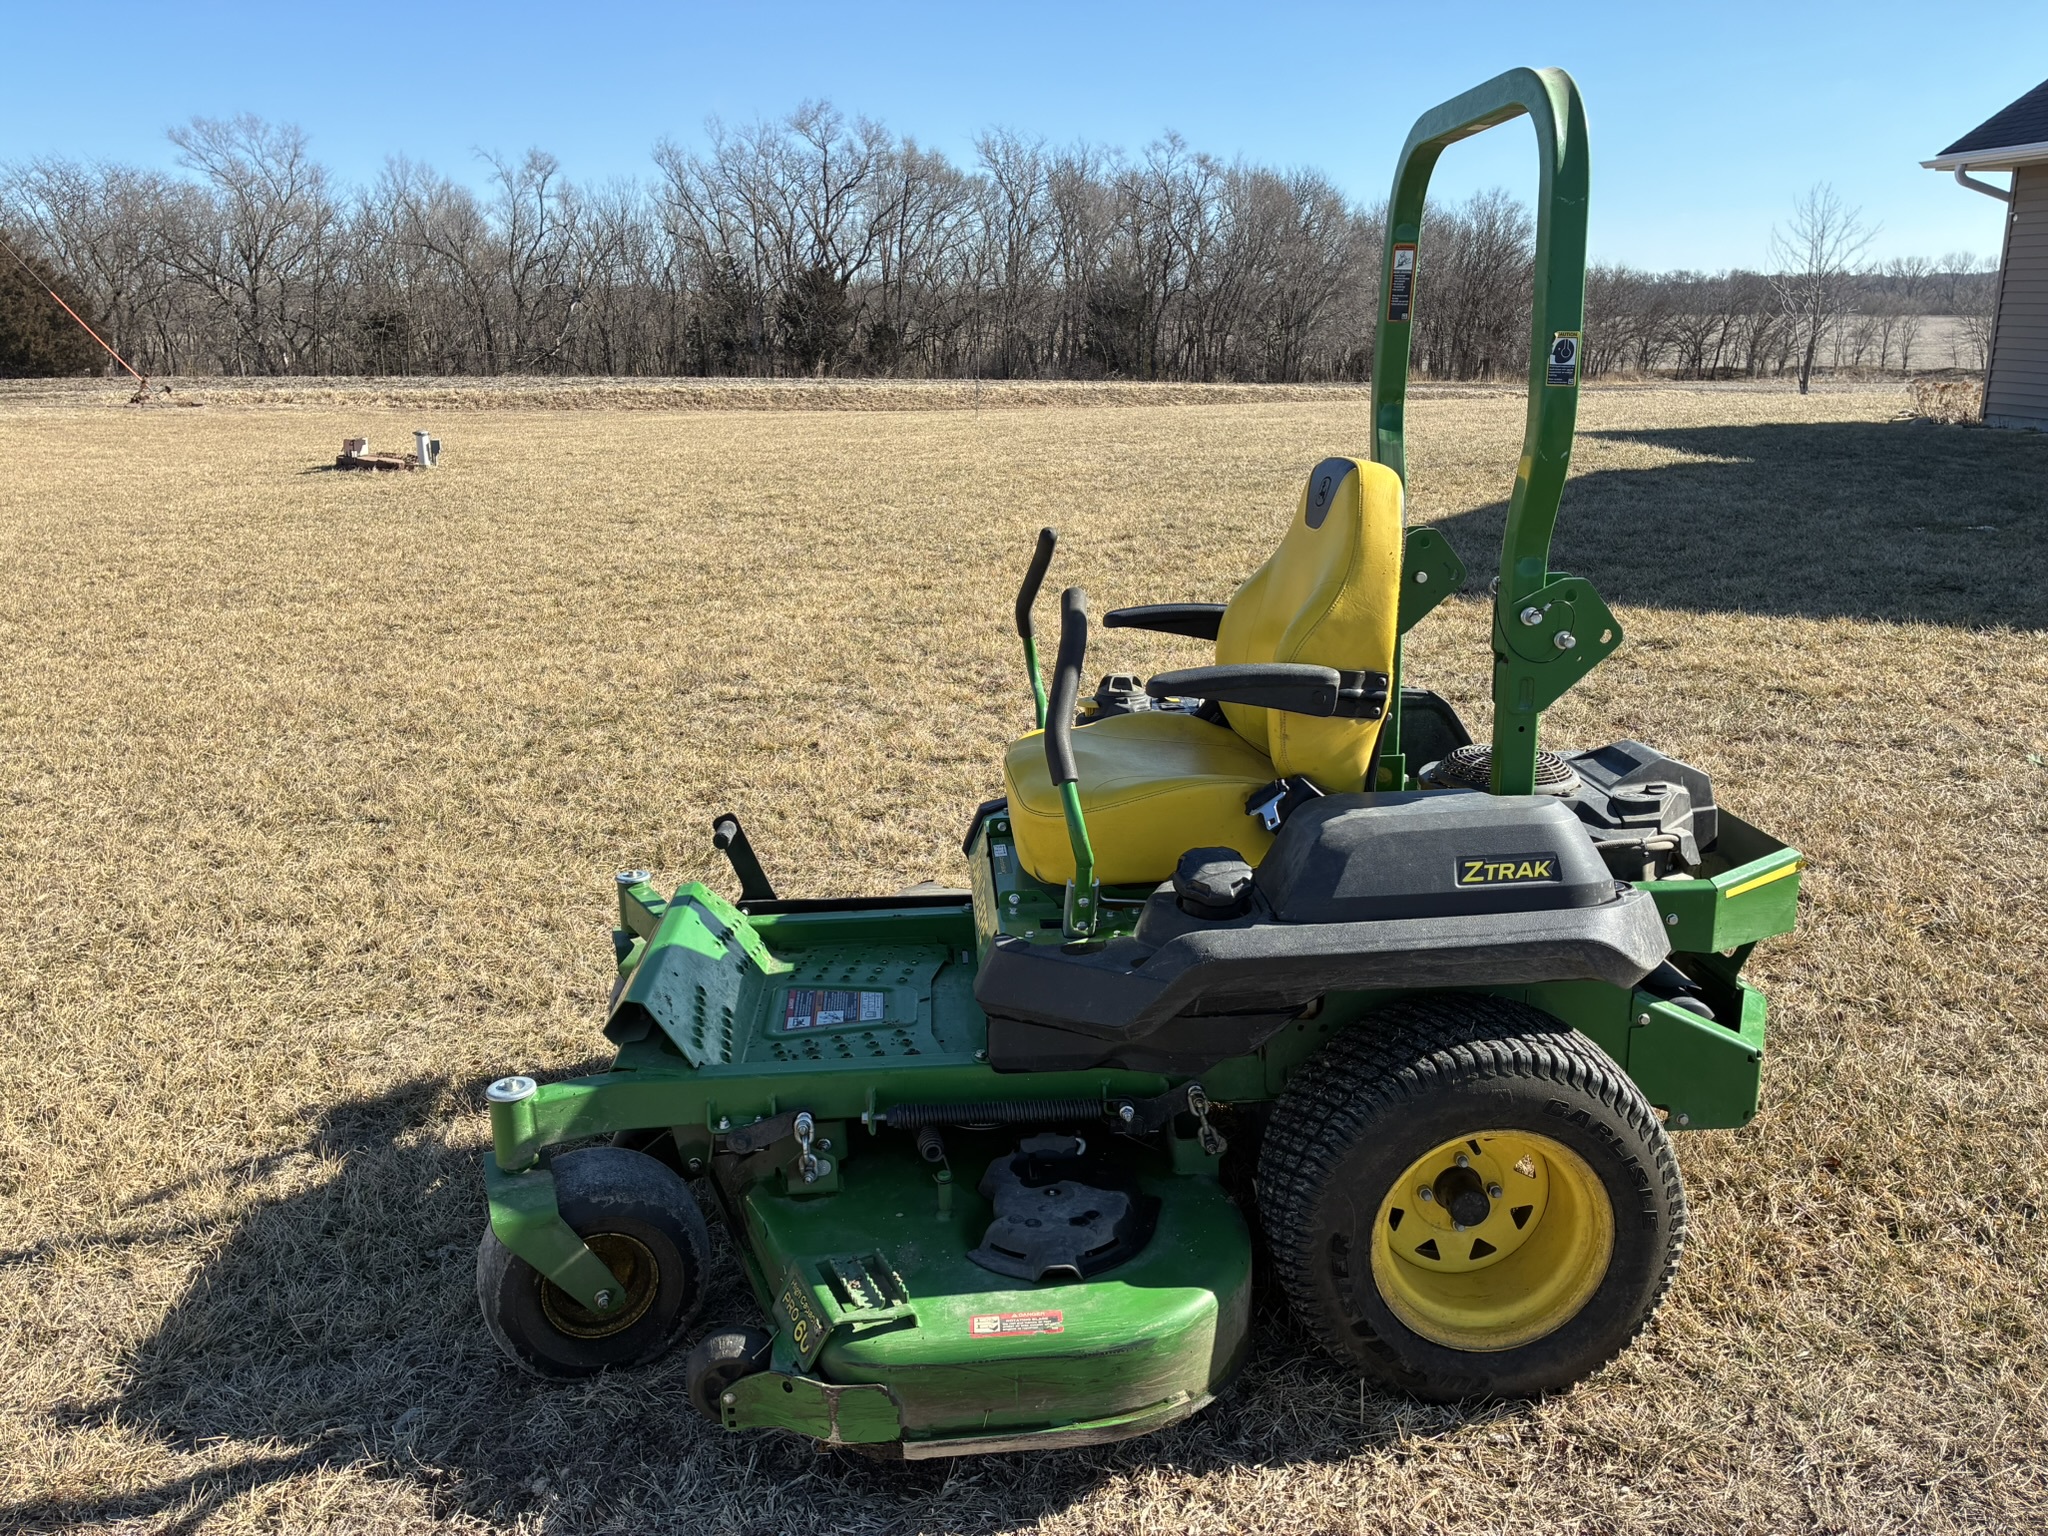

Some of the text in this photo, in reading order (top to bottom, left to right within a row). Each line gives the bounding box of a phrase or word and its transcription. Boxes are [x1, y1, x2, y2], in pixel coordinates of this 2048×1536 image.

[1462, 860, 1551, 882] ZTRAK
[1543, 1098, 1660, 1232] CARLISLE
[782, 1291, 799, 1322] PRO
